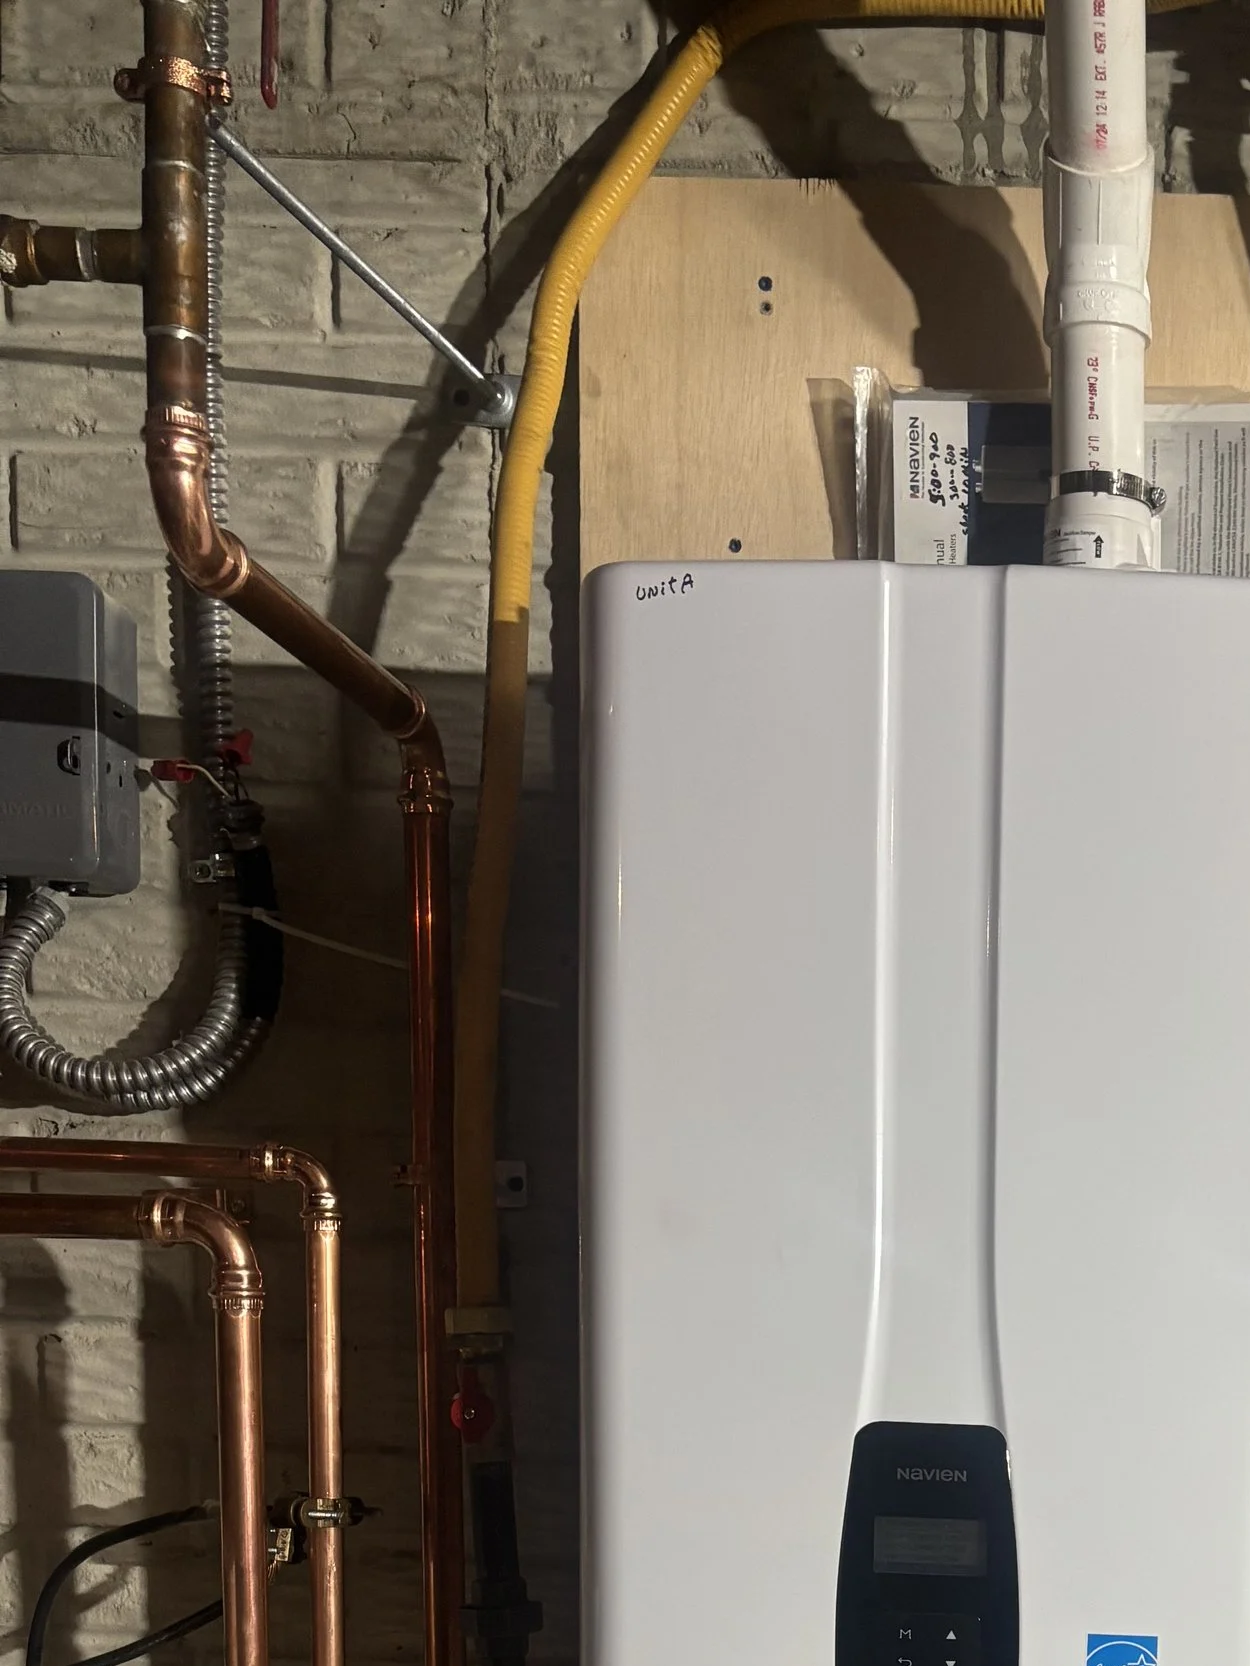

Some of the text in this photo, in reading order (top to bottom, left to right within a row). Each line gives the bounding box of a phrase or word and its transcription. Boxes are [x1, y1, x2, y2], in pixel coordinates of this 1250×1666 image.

[949, 534, 958, 564] Heaters
[681, 573, 694, 594] A
[899, 1628, 912, 1640] M
